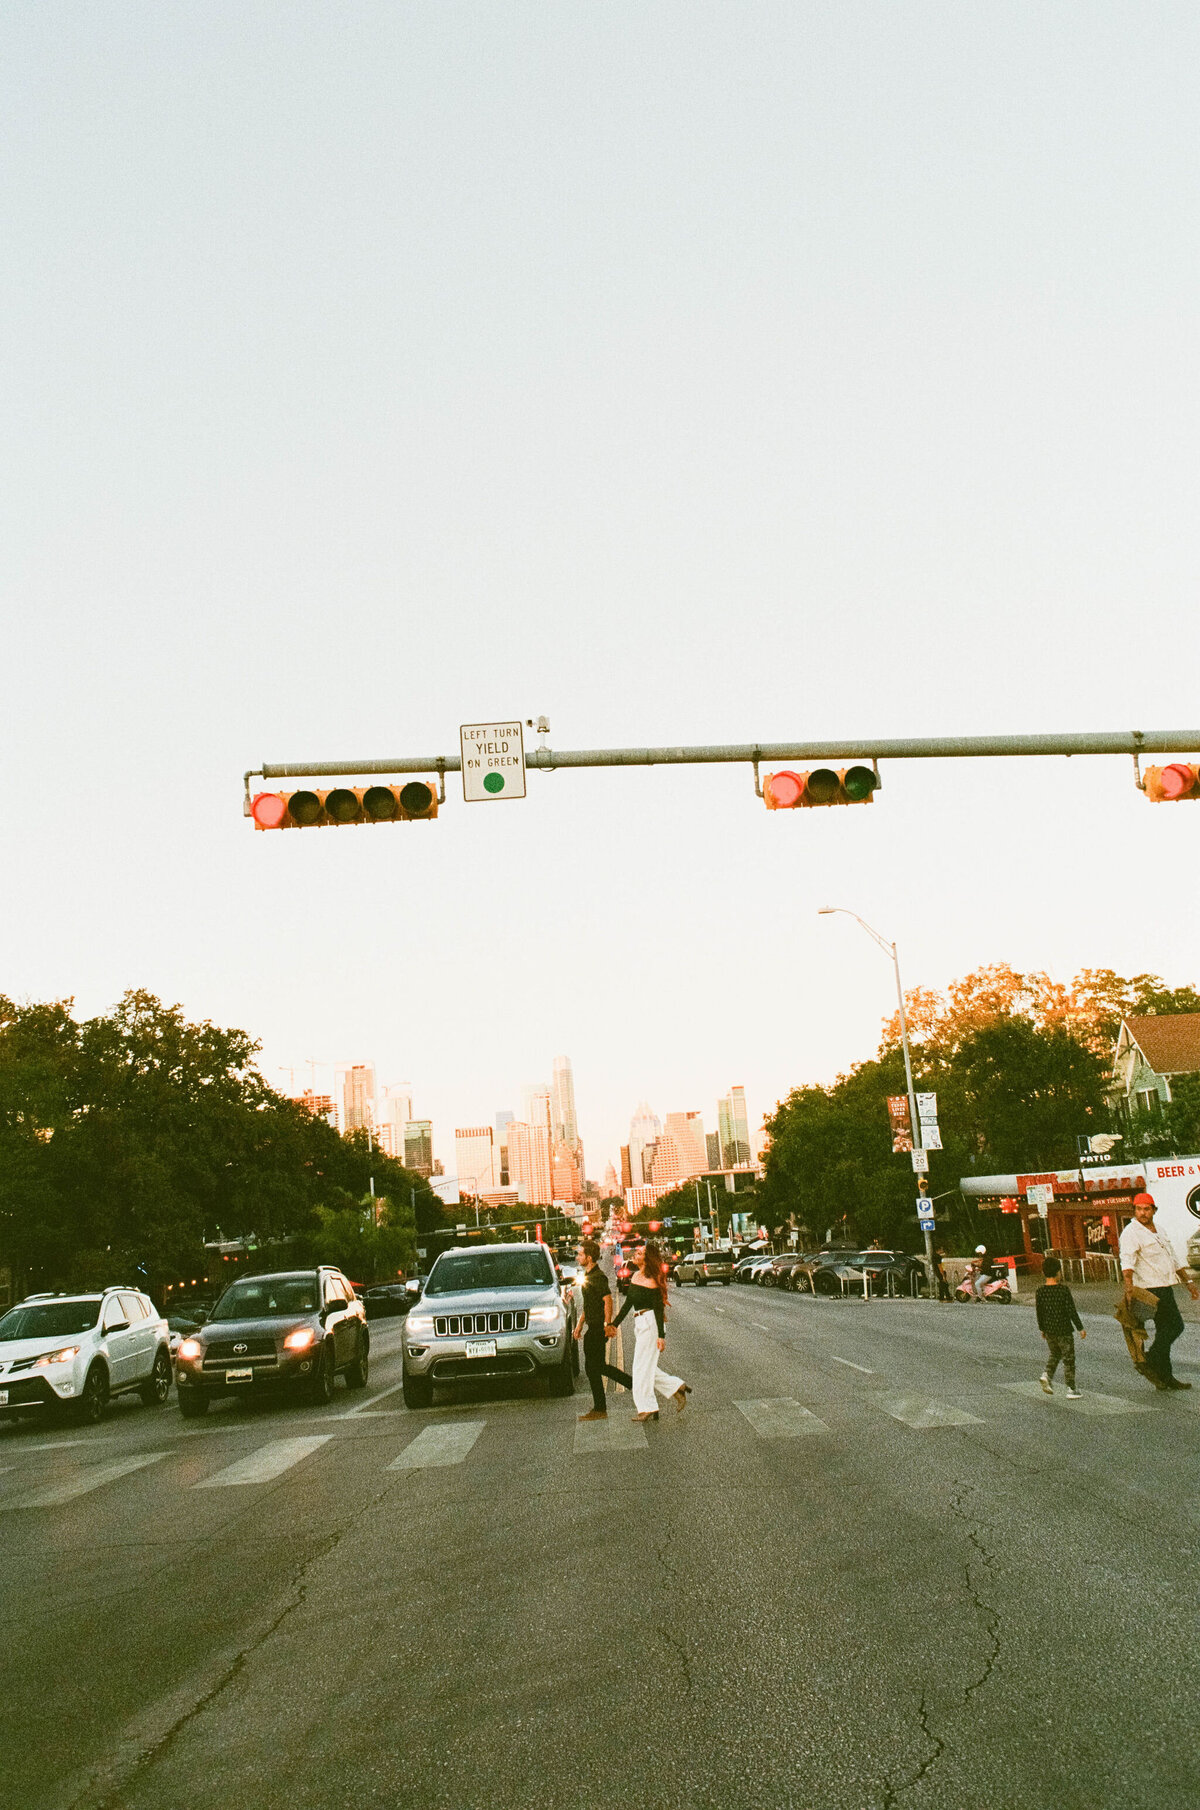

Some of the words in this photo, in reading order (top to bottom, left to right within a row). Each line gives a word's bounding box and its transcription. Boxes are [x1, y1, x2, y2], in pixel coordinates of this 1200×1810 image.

[464, 730, 487, 740] LEFT
[494, 728, 519, 738] TURN
[476, 742, 509, 754] YIELD
[467, 759, 480, 768] ON
[487, 756, 519, 767] GREEN
[1080, 1154, 1111, 1163] PATIO
[1157, 1165, 1185, 1179] BEER
[1188, 1166, 1195, 1175] &
